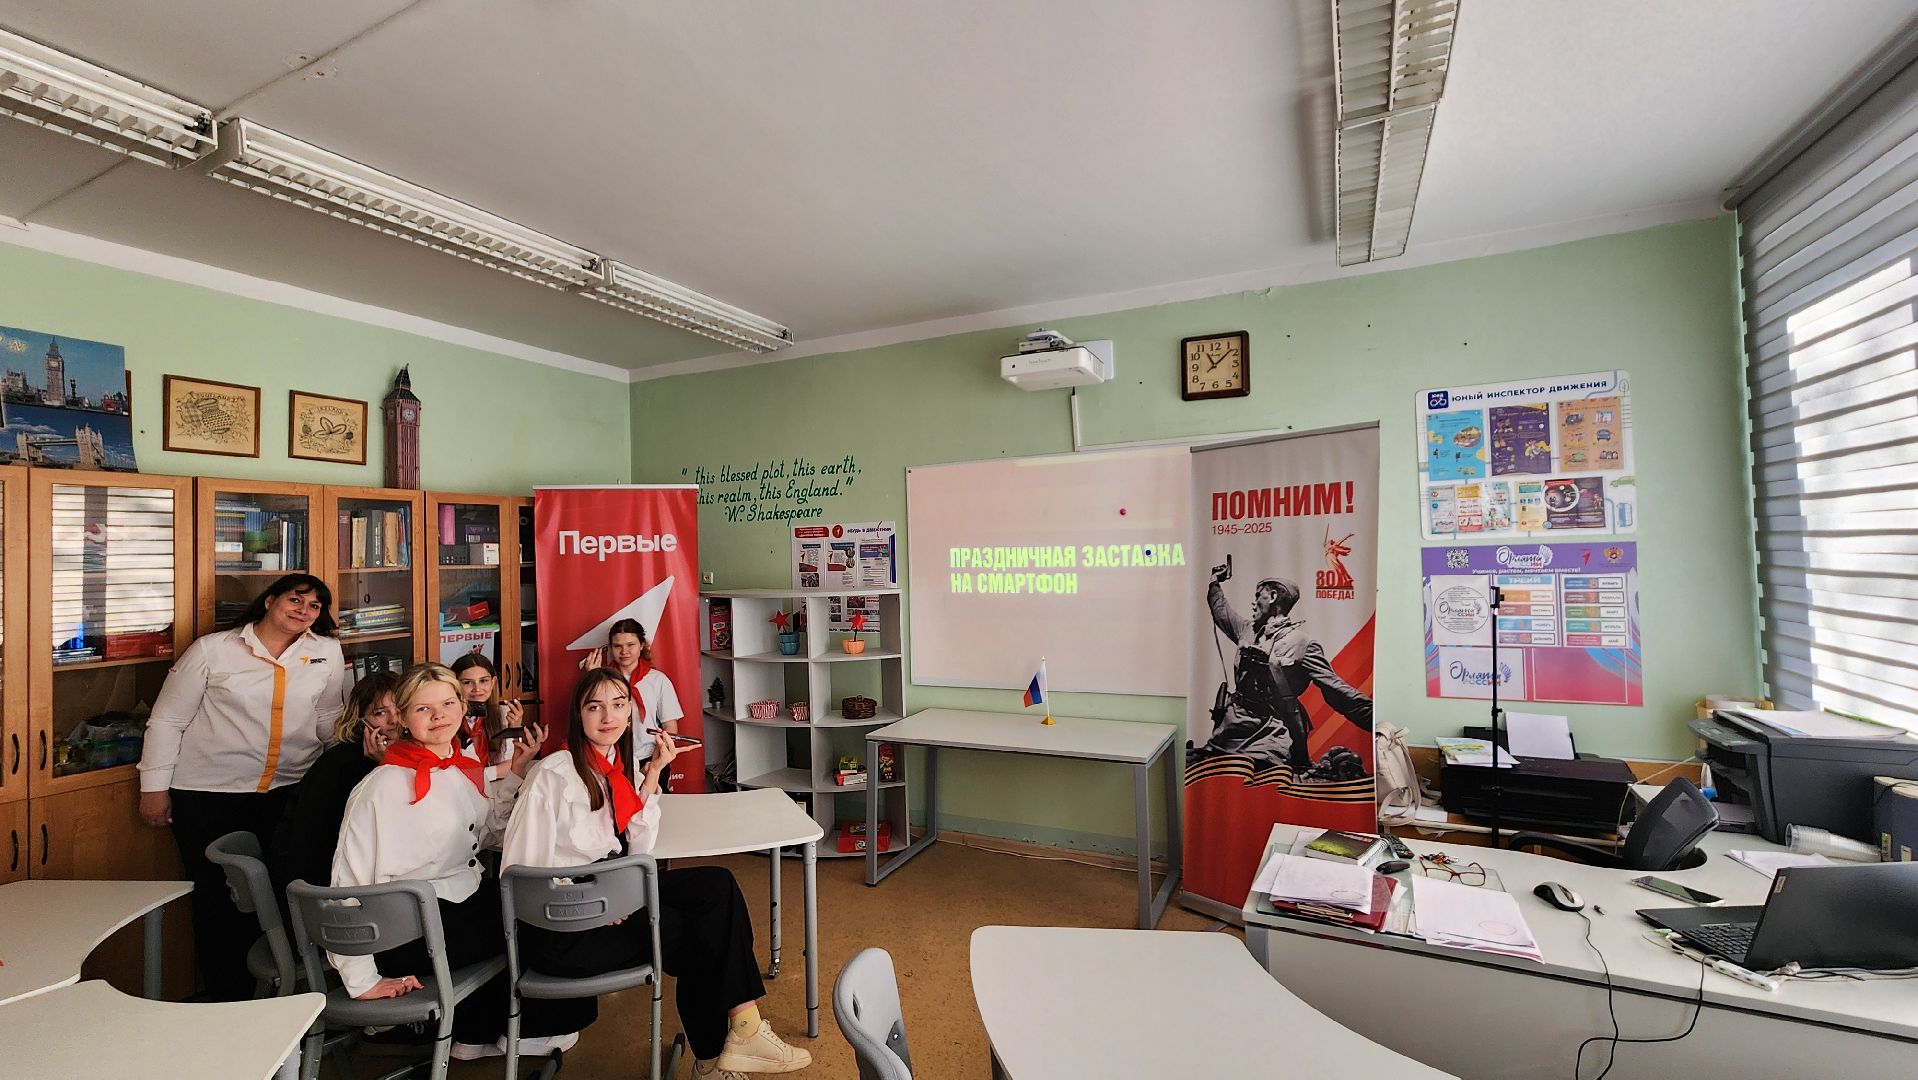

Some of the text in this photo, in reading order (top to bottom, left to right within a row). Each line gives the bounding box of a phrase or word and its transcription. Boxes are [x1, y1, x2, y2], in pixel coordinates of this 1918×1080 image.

[1197, 344, 1204, 352] 11
[1210, 342, 1222, 351] 12
[1226, 341, 1230, 349] 1
[1192, 364, 1199, 372] 9
[1232, 360, 1239, 368] 3
[1192, 375, 1199, 384] 8
[1212, 380, 1219, 388] 6
[1226, 380, 1232, 388] 5
[1452, 380, 1607, 402] ЮНЫЙ ИНСПЕКТОР ДВИЖЕНИЯ
[695, 466, 716, 485] this
[720, 462, 758, 483] blessed
[760, 459, 790, 484] plot,
[792, 457, 816, 477] this
[821, 455, 862, 476] earth,
[717, 484, 757, 506] realm,
[760, 482, 782, 500] this
[1212, 481, 1354, 521] ПОМНИМ!
[724, 503, 823, 526] W. Shakespeare
[559, 530, 678, 562] Первые
[950, 542, 1186, 571] ПРАЗДНИЧНАЯ ЗАСТАВКА
[950, 572, 1078, 594] НА СМАРТФОН
[1316, 570, 1336, 588] 80
[1508, 576, 1541, 584] ТРЕКИ
[1316, 590, 1354, 600] ПОБЕДА!
